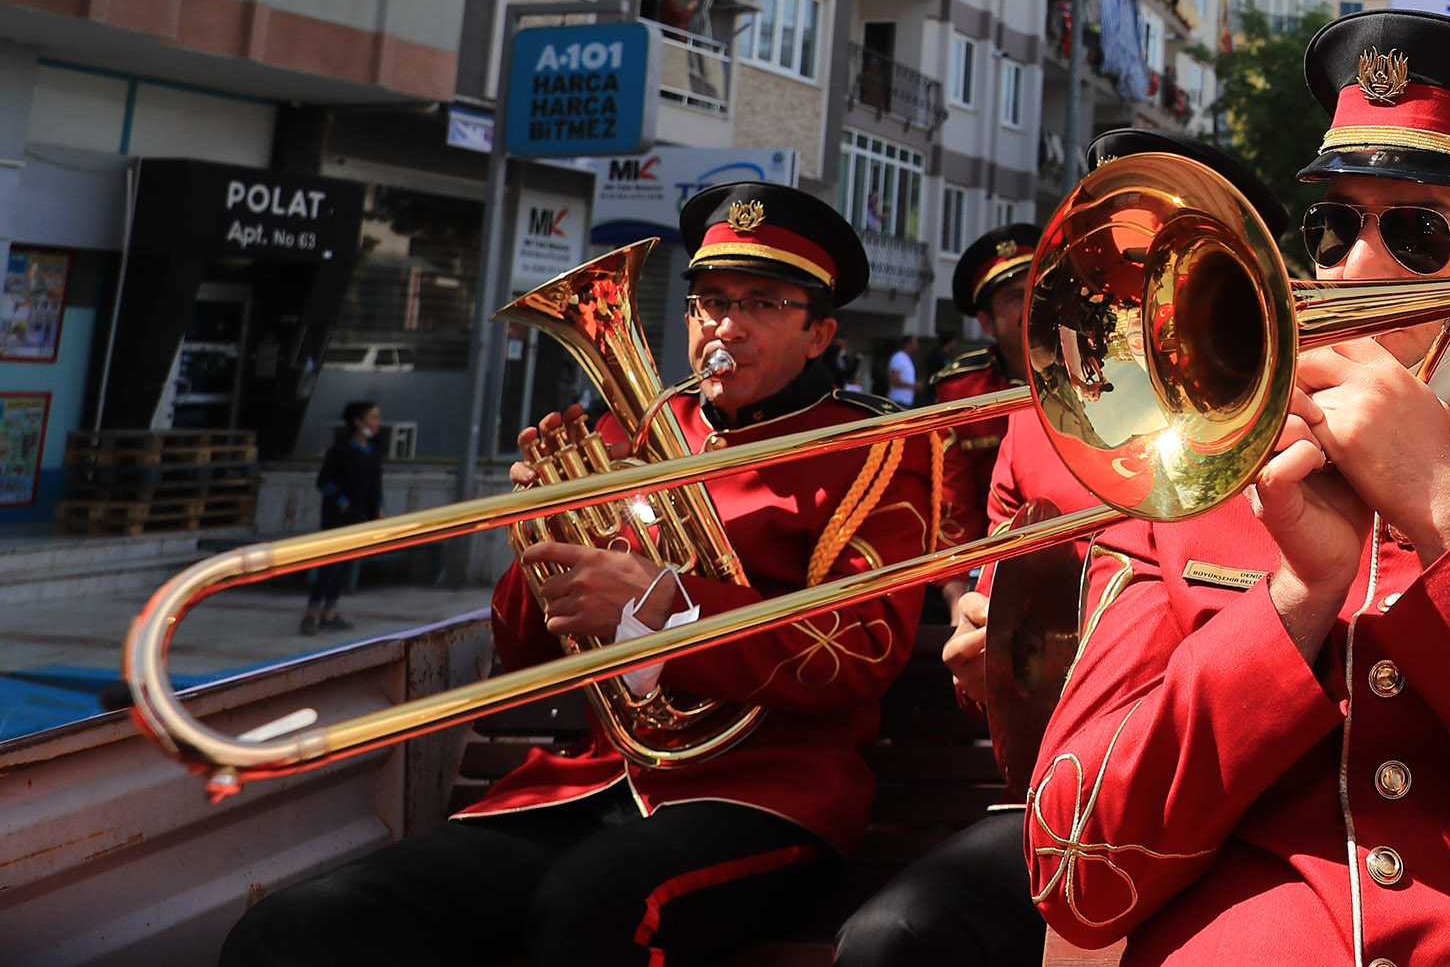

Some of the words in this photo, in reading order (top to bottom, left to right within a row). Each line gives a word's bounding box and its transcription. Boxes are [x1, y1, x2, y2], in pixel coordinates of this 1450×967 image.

[532, 72, 619, 94] HARCA
[531, 95, 618, 117] HARCA
[226, 180, 326, 219] POLAT
[226, 220, 268, 249] Apt.
[273, 228, 295, 247] No
[1192, 570, 1239, 583] BÜYÜKŞEHİR
[1240, 572, 1263, 580] DENİZ
